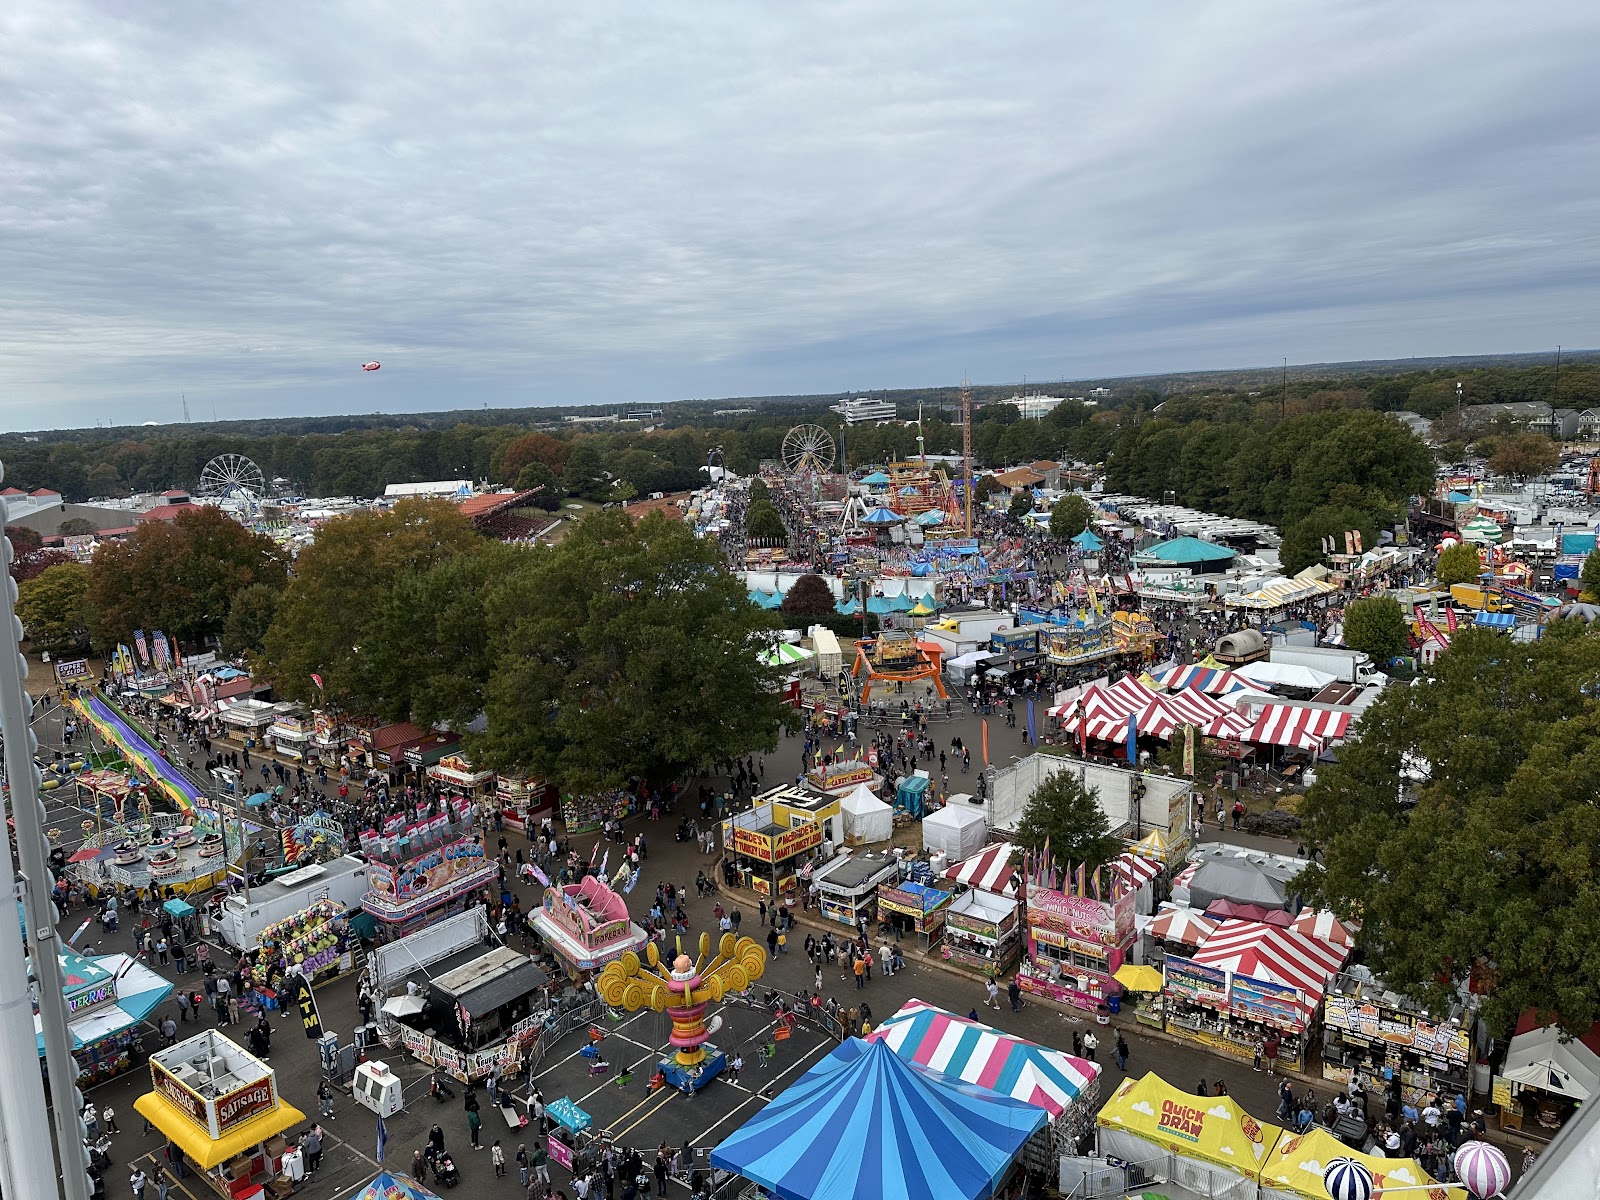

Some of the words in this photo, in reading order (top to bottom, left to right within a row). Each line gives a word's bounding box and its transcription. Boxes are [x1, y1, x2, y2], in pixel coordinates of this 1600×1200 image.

[60, 663, 82, 672] SUPER
[66, 665, 85, 676] SLIDE
[841, 679, 849, 700] ATM
[195, 797, 210, 809] TEA
[739, 841, 758, 857] TURKEY
[758, 849, 771, 861] LEGS
[775, 847, 791, 861] GIANT
[791, 836, 809, 853] TURKEY
[810, 831, 822, 844] LEGS
[397, 849, 444, 895] FUNNEL
[445, 843, 485, 860] CAKES
[1040, 889, 1067, 904] Deep
[1067, 897, 1104, 915] Fried
[1046, 904, 1062, 913] MINI
[1062, 907, 1092, 920] DONUTS
[595, 928, 626, 946] POPCORN
[1036, 930, 1062, 946] MINI
[298, 986, 319, 1029] ATM
[320, 1043, 329, 1071] ATM
[329, 1042, 338, 1070] ATM
[163, 1078, 197, 1115] SAUSAGE
[221, 1086, 270, 1122] SAUSAGE
[359, 1091, 378, 1109] ICE
[390, 1086, 398, 1113] ICE
[1162, 1100, 1206, 1124] QUICK
[1158, 1113, 1203, 1138] DRAW
